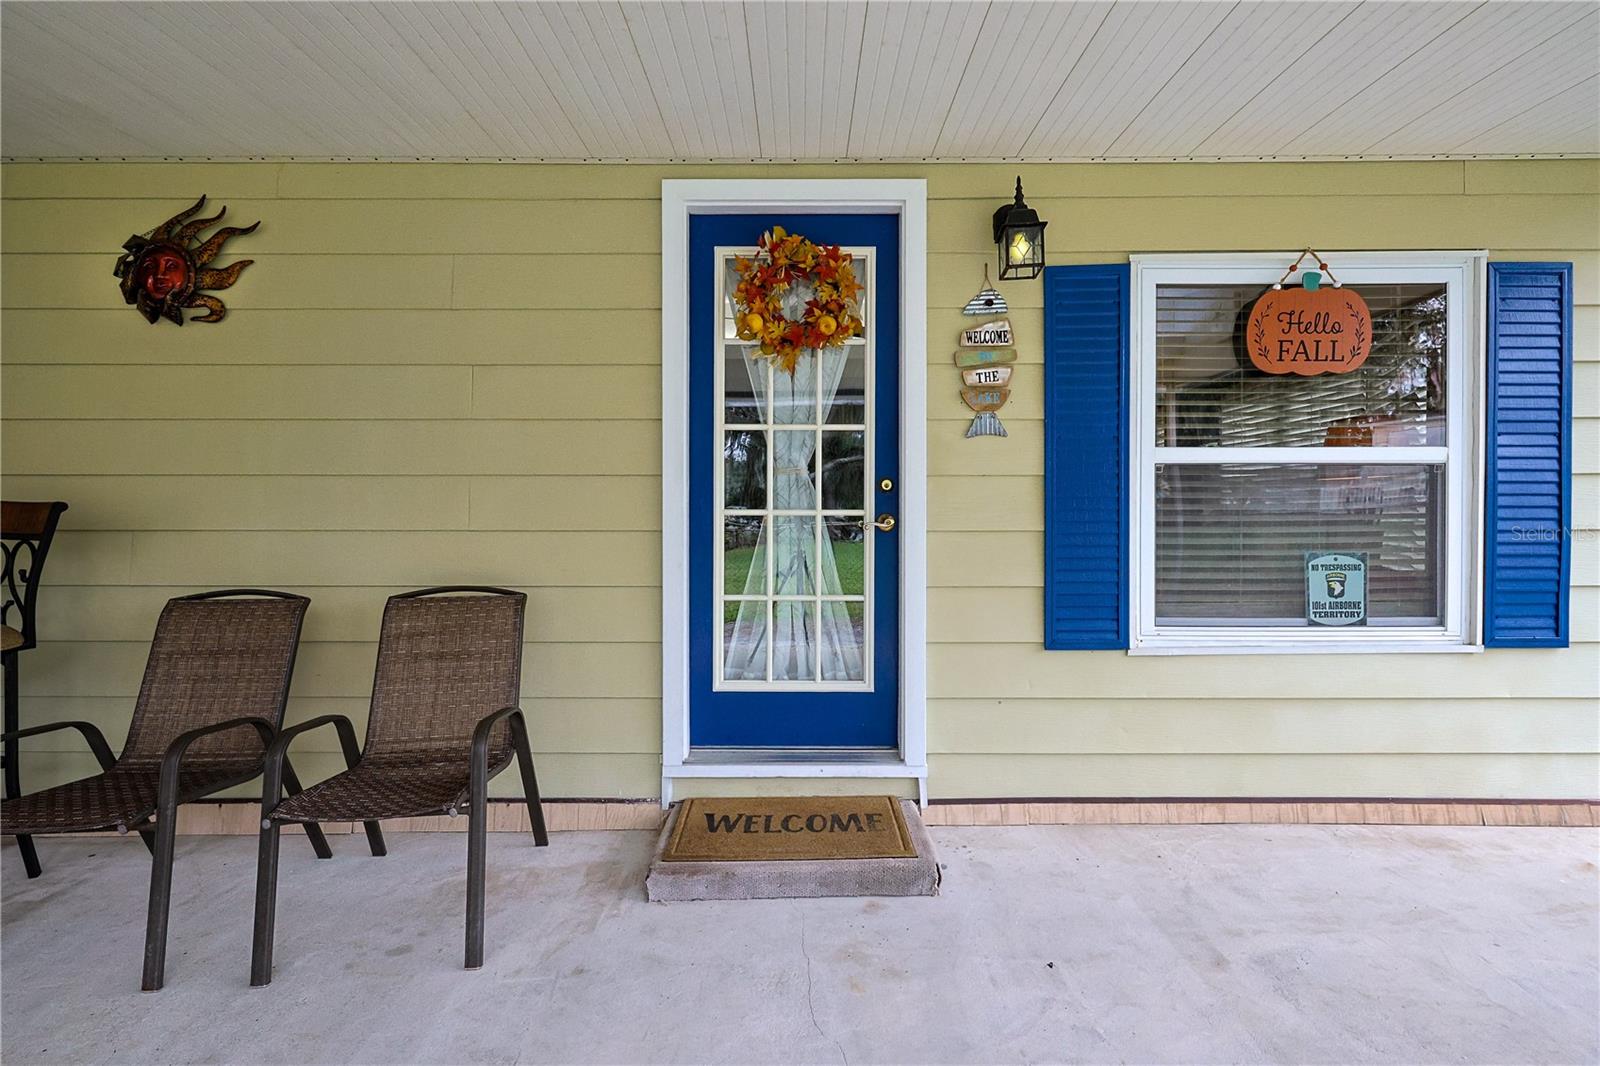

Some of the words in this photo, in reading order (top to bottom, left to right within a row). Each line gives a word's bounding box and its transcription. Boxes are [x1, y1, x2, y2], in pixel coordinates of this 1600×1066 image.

[1277, 310, 1344, 335] Hello
[965, 330, 1009, 344] WELCOME
[1277, 339, 1345, 362] FALL
[975, 370, 1000, 384] THE
[1311, 563, 1319, 571] NO
[1320, 563, 1362, 572] TRESPASSING
[1328, 601, 1362, 610] AIRBORNE
[1312, 611, 1362, 619] TERRITORY
[704, 812, 886, 833] WELCOME
